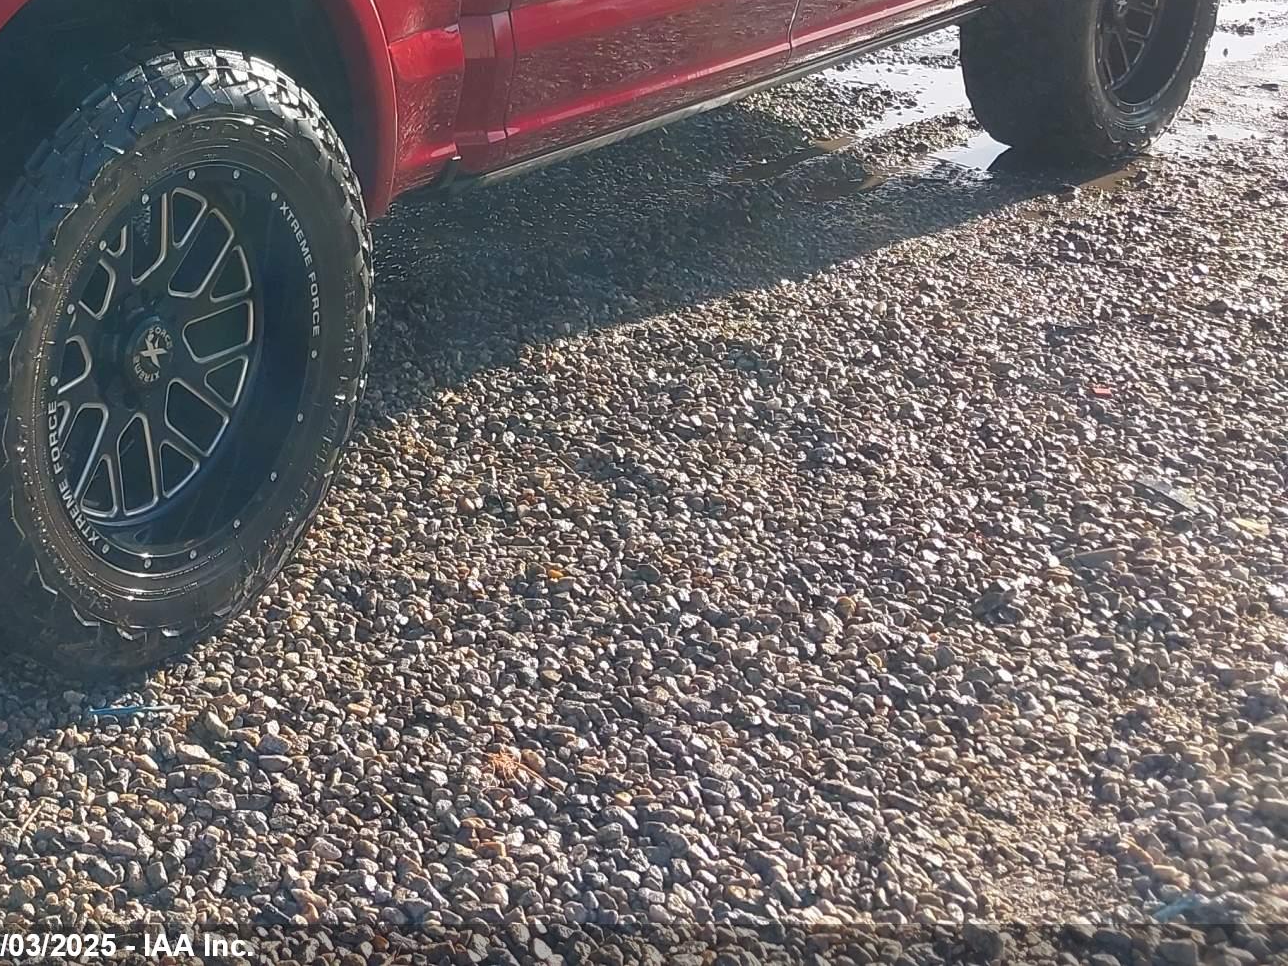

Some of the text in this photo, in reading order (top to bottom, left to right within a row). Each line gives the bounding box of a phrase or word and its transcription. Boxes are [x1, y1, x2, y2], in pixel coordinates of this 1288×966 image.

[279, 201, 320, 337] XTREME FORCE
[47, 400, 100, 546] XTREME FORCE
